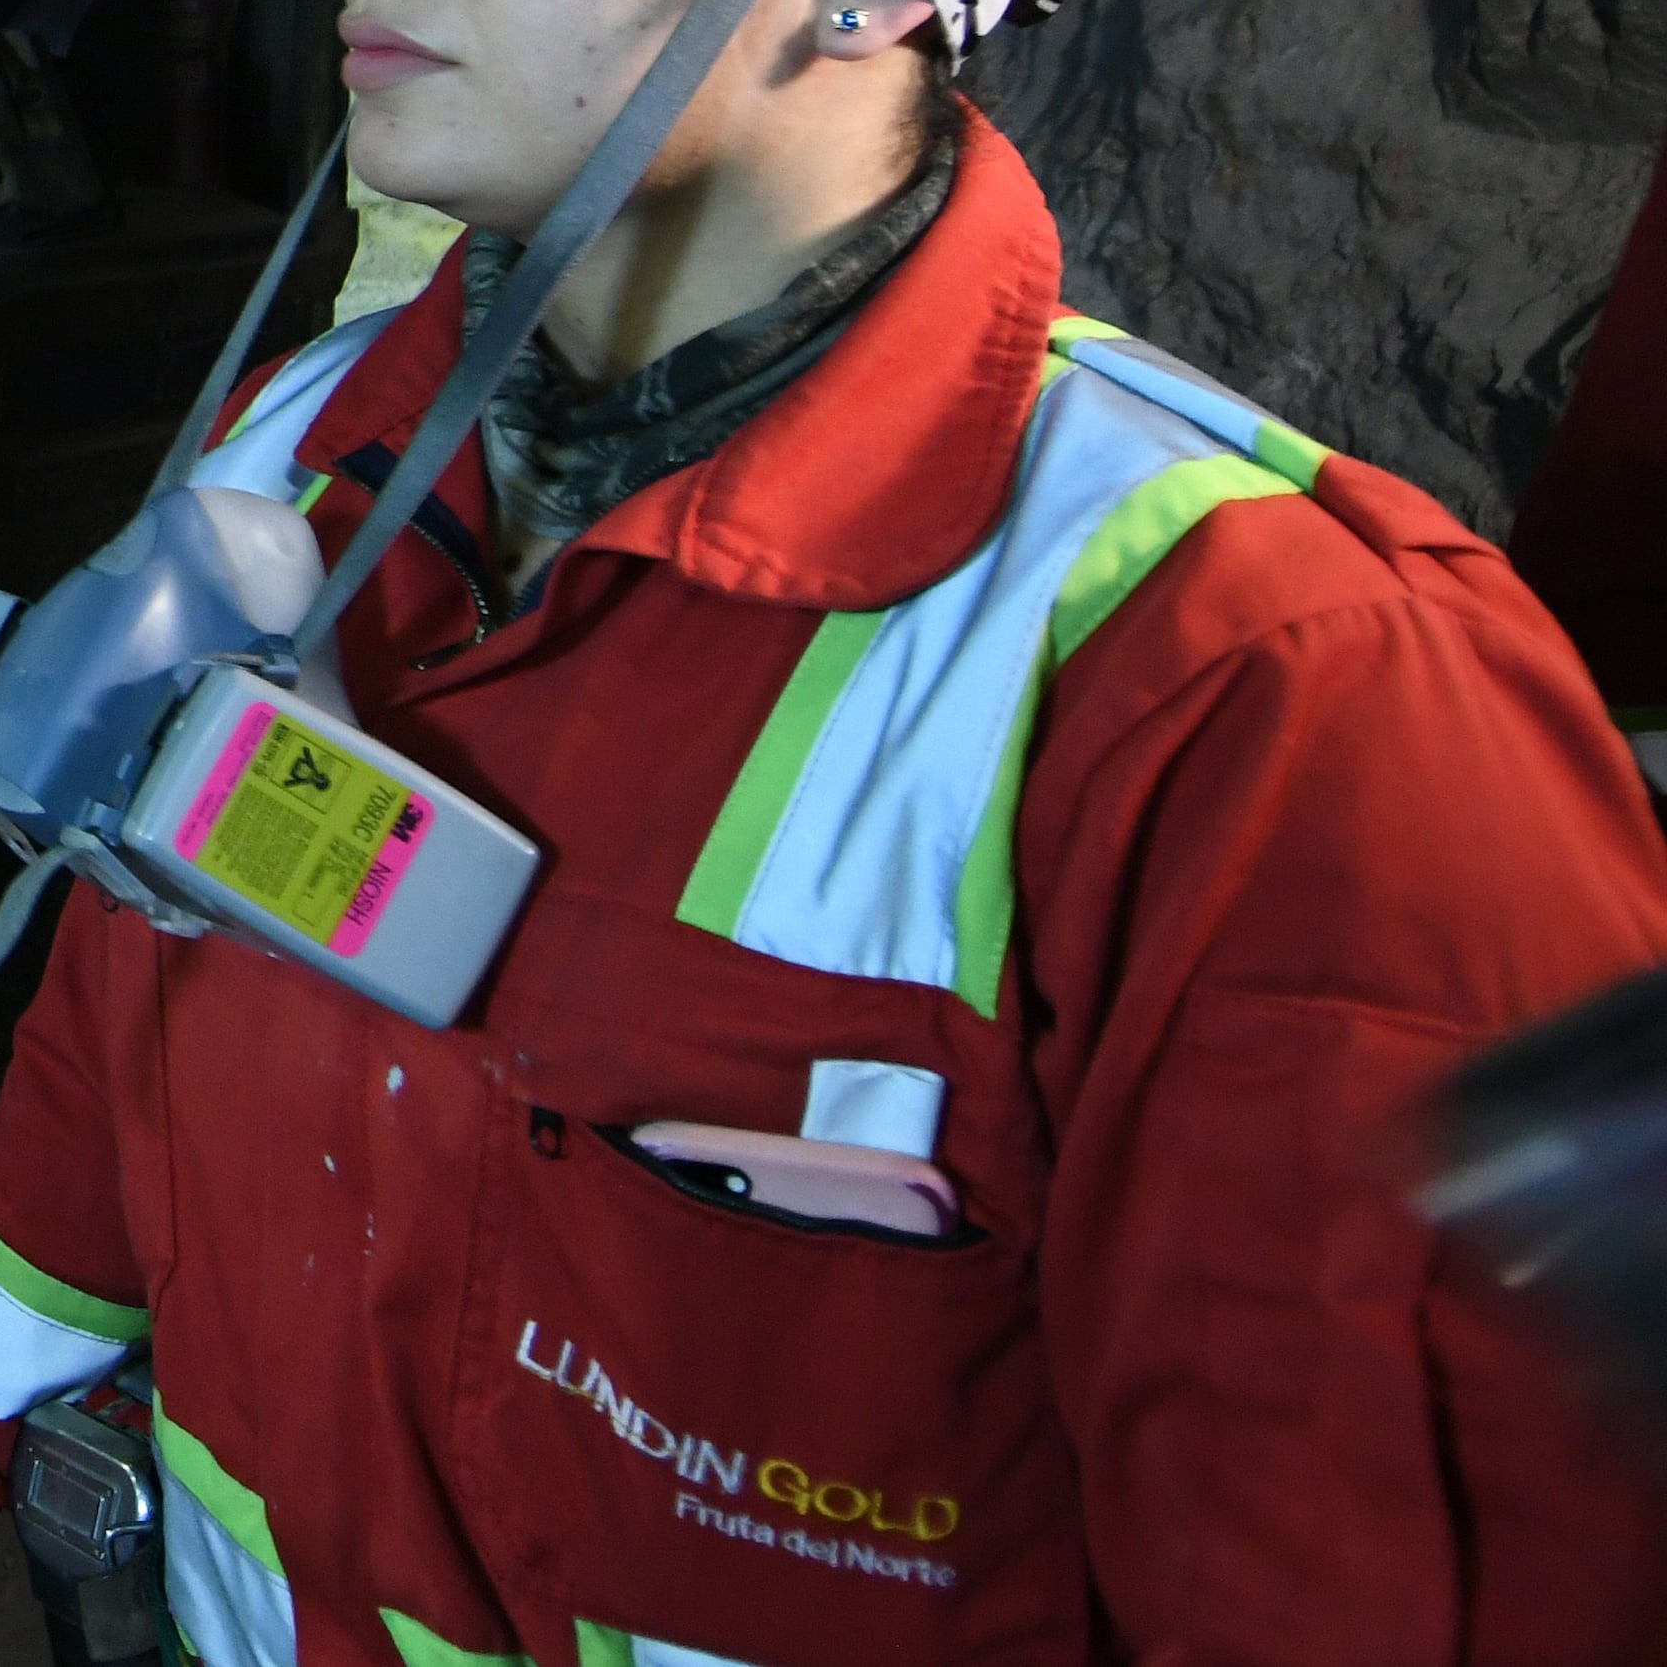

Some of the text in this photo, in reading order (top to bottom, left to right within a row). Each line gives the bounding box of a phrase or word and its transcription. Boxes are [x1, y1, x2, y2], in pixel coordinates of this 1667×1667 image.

[344, 802, 424, 927] 3M NIOSH
[352, 784, 399, 844] 7093C
[516, 1319, 960, 1542] LUNDIN GOLD
[675, 1490, 957, 1588] Fruta del Norte
